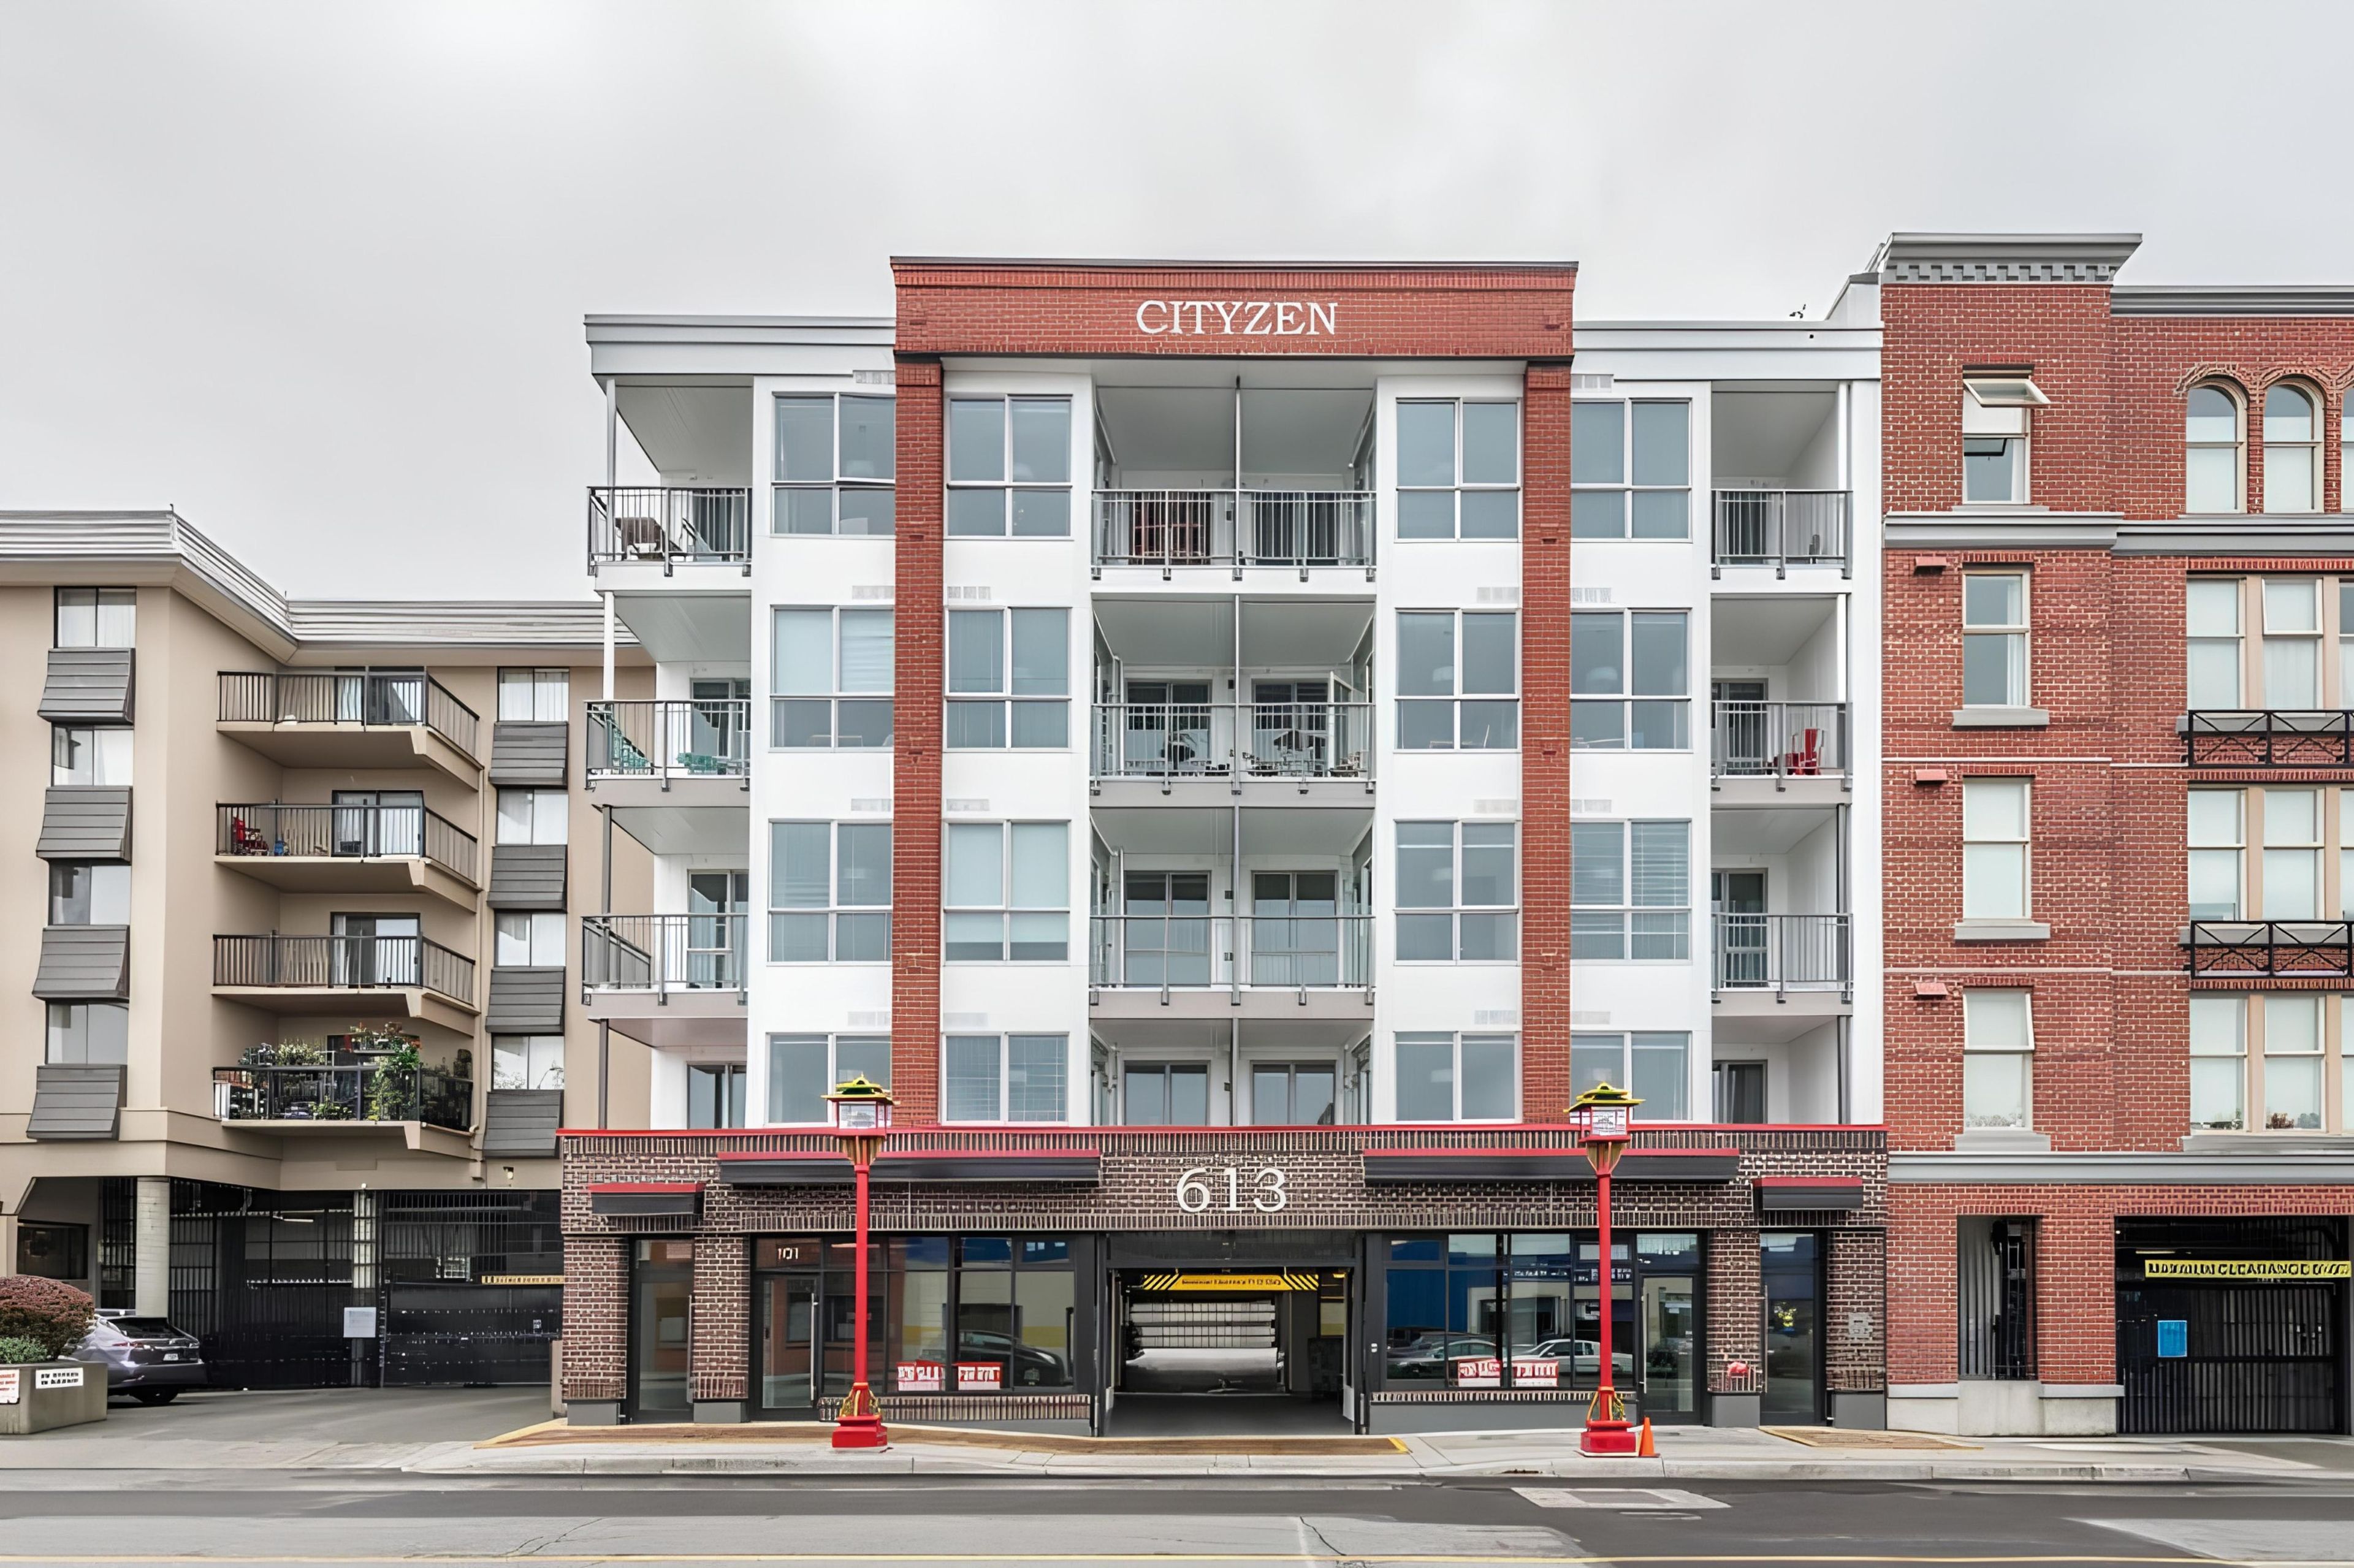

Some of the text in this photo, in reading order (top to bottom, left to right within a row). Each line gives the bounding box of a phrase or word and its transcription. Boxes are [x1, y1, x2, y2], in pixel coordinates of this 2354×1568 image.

[1136, 300, 1338, 335] CITYZEN
[1176, 1167, 1286, 1212] 613
[778, 1247, 798, 1260] 101
